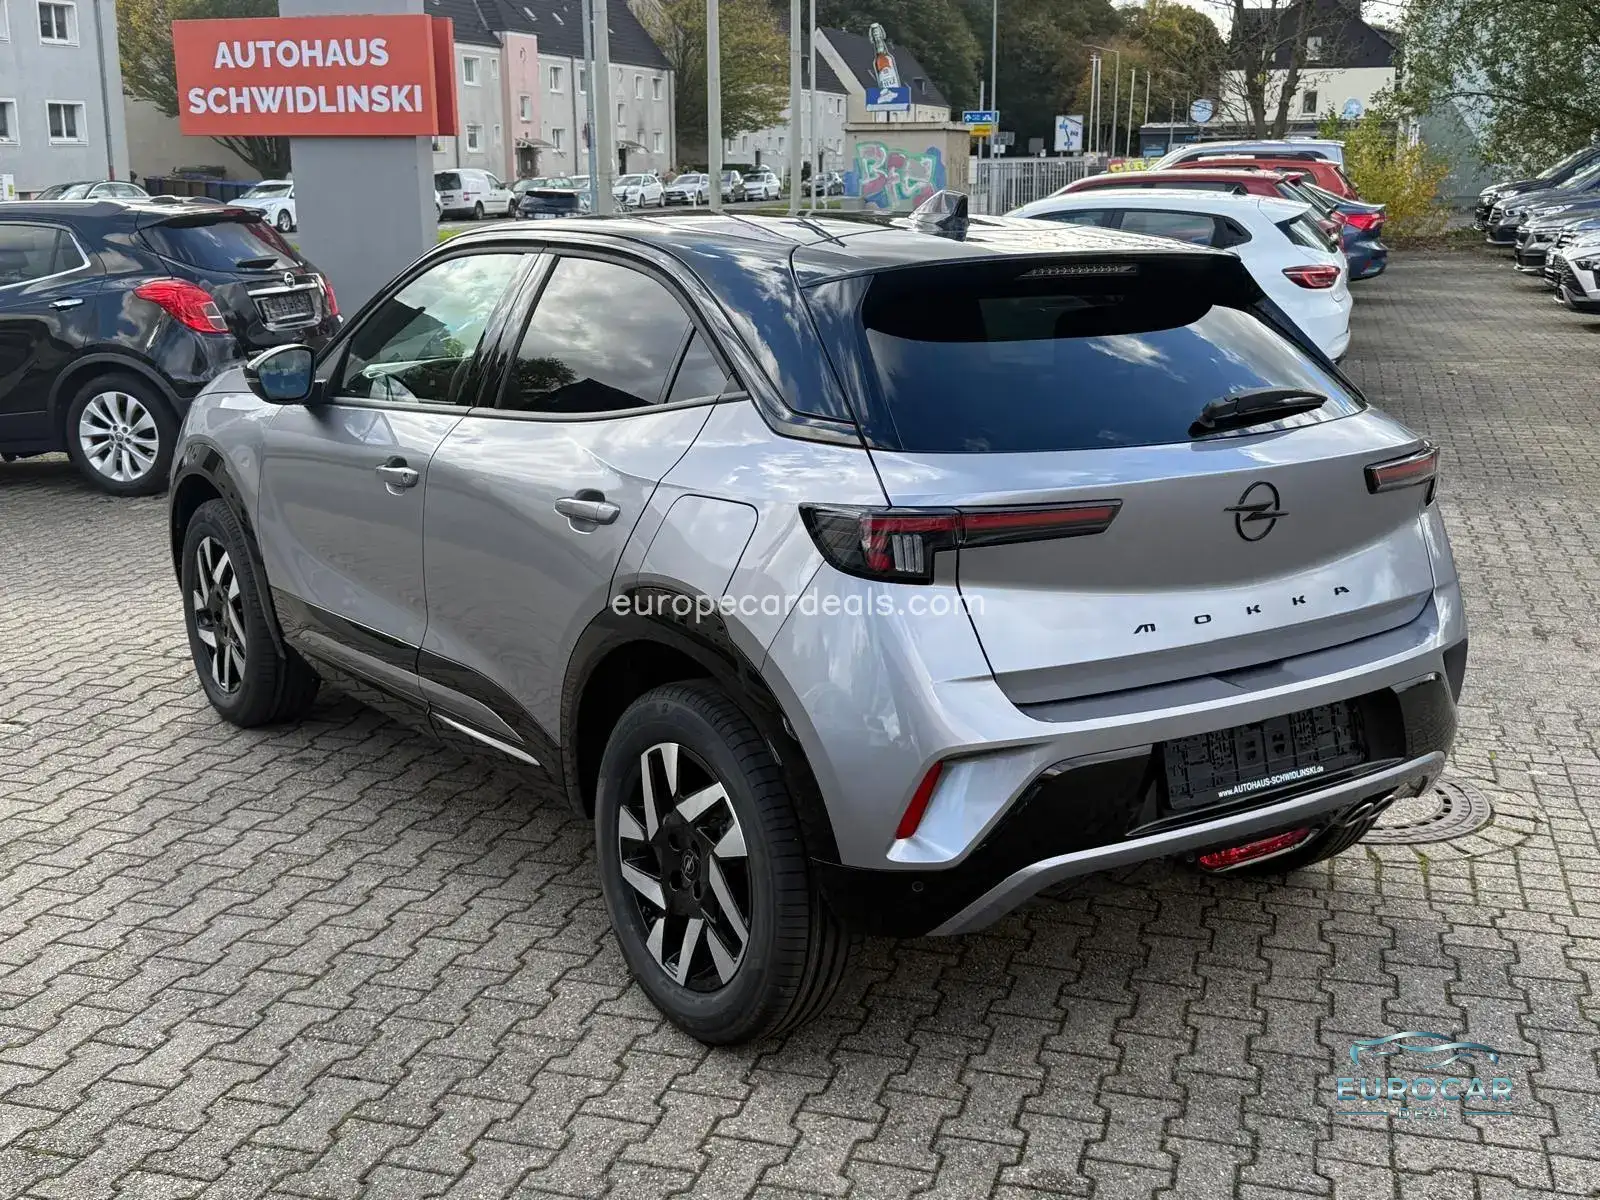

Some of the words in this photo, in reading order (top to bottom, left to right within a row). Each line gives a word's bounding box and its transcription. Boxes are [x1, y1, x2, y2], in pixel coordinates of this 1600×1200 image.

[214, 38, 389, 69] AUTOHAUS
[188, 85, 423, 114] SCHWIDLINSKI
[1134, 586, 1350, 634] MOKKA
[1218, 765, 1324, 798] www.AUTOHAUS-SCHWIDLINSKI.de
